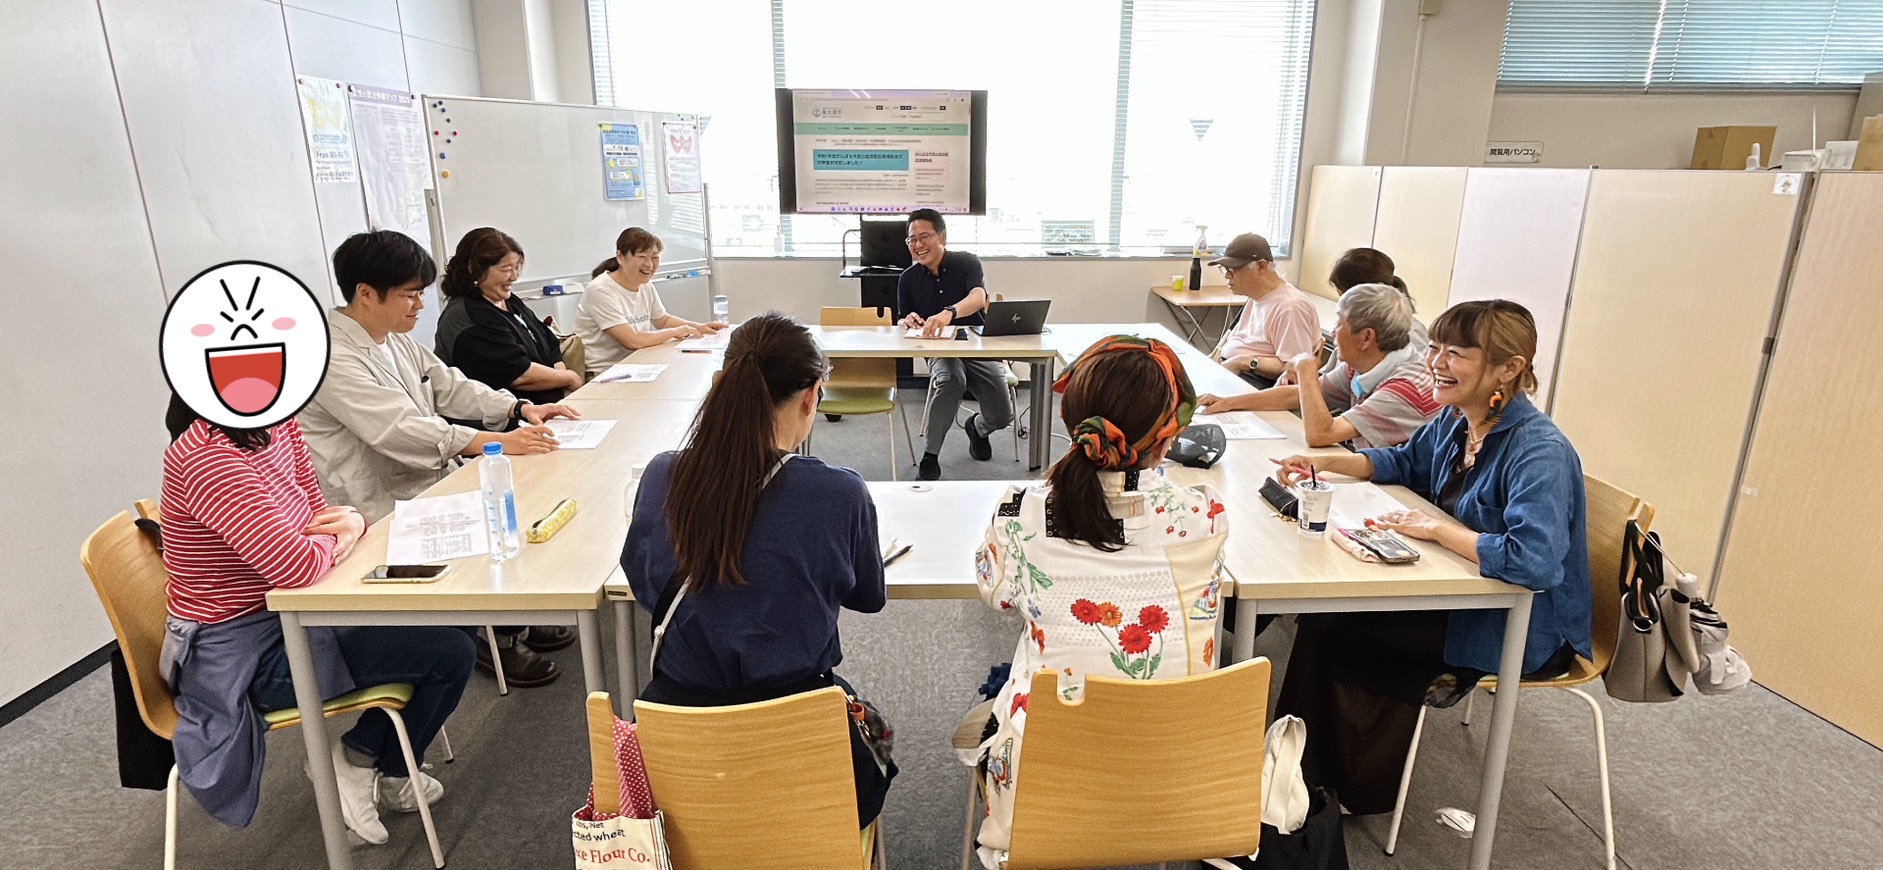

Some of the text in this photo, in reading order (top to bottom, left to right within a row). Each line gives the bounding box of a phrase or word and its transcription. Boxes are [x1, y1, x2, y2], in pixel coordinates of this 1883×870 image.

[593, 829, 625, 841] whea
[590, 849, 625, 864] Flour
[628, 847, 650, 862] Co.
